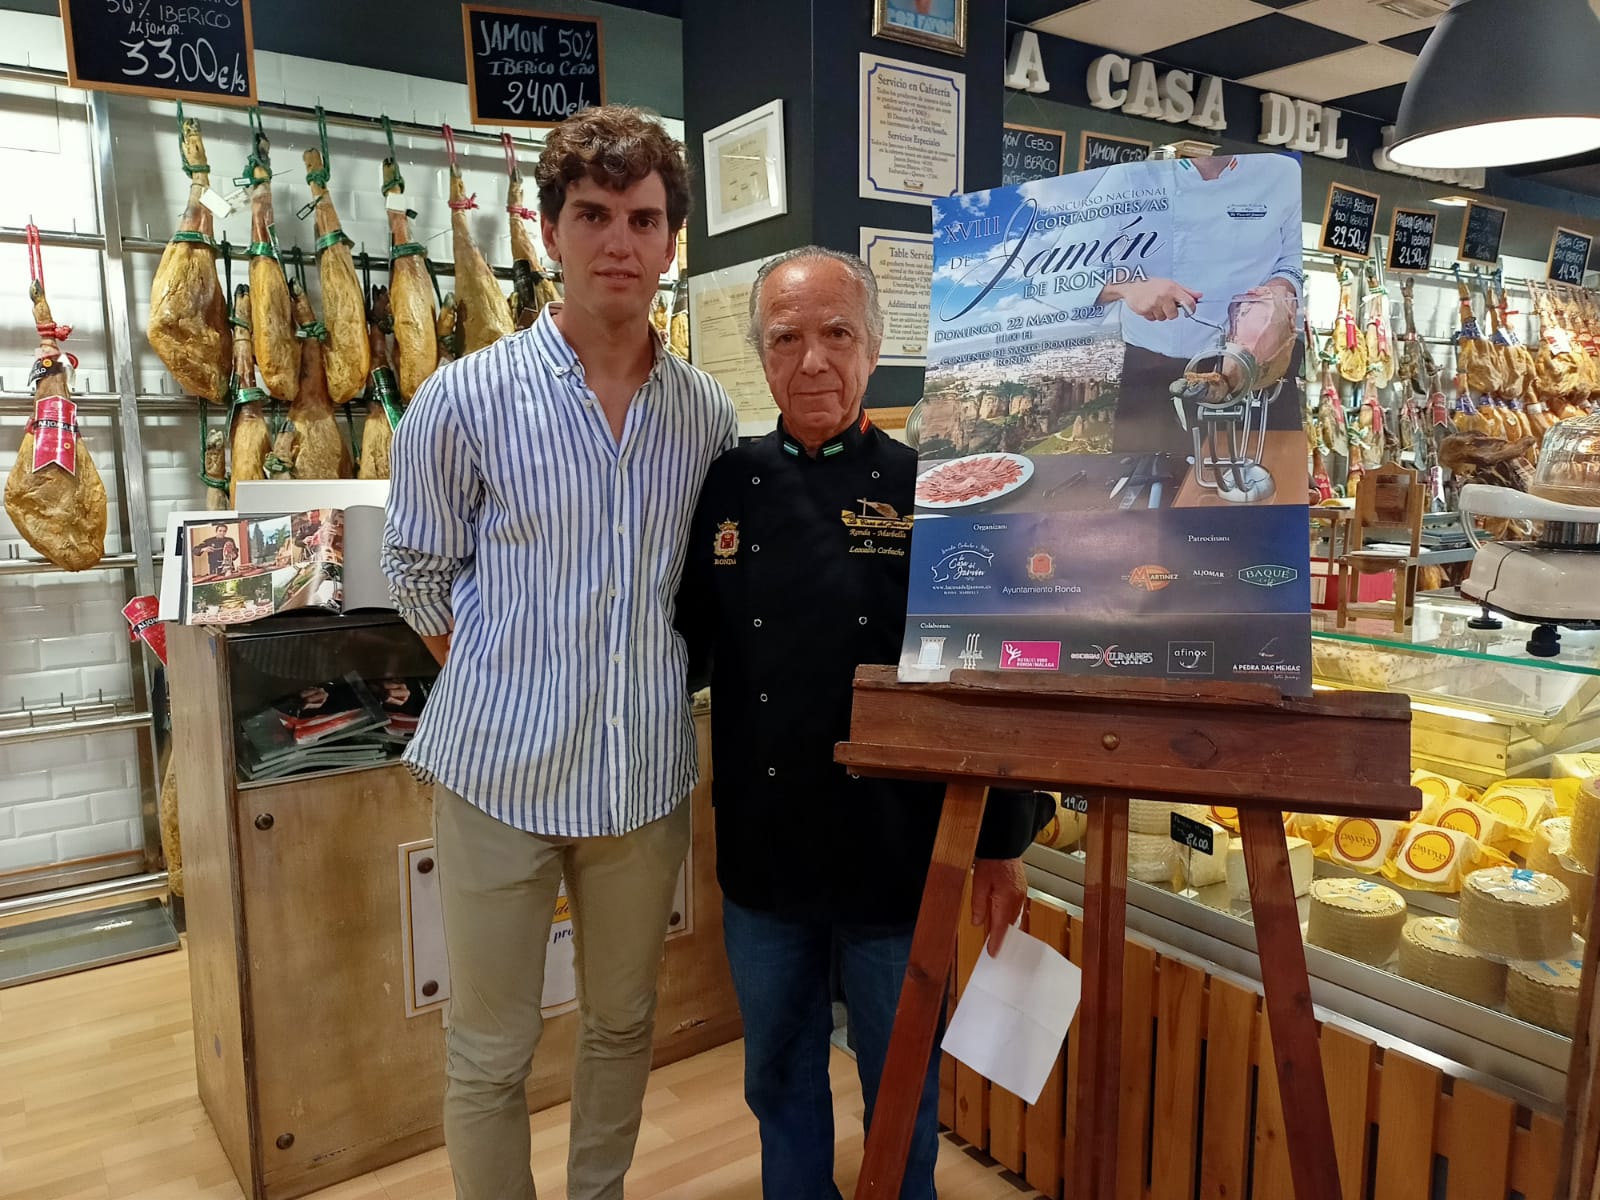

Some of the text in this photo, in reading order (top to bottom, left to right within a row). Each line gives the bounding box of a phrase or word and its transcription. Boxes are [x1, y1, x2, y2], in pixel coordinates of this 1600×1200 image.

[558, 28, 594, 62] 50%
[877, 73, 951, 98] Servicio en Cafetería
[1005, 30, 1050, 93] A
[1086, 53, 1227, 130] CASA
[1258, 92, 1349, 159] DEL
[1024, 134, 1054, 152] CEBO
[1034, 198, 1169, 231] CORTADORES/AS
[1040, 187, 1168, 216] CONCURSO NACIONAL
[943, 216, 1001, 244] XVIII
[889, 247, 909, 258] Table
[939, 198, 1166, 322] Jamón
[1024, 264, 1149, 300] DE RONDA
[1006, 316, 1024, 331] 22
[1026, 310, 1069, 328] MAYO
[1071, 305, 1105, 321] 2022
[940, 351, 992, 366] CONVENTO
[993, 348, 1006, 358] DE
[1041, 336, 1095, 351] DOMINGO
[995, 354, 1032, 368] RONDA
[1002, 585, 1082, 596] Ayuntamiento Ronda
[1174, 648, 1207, 658] afinox
[1276, 664, 1301, 672] MEIGAS
